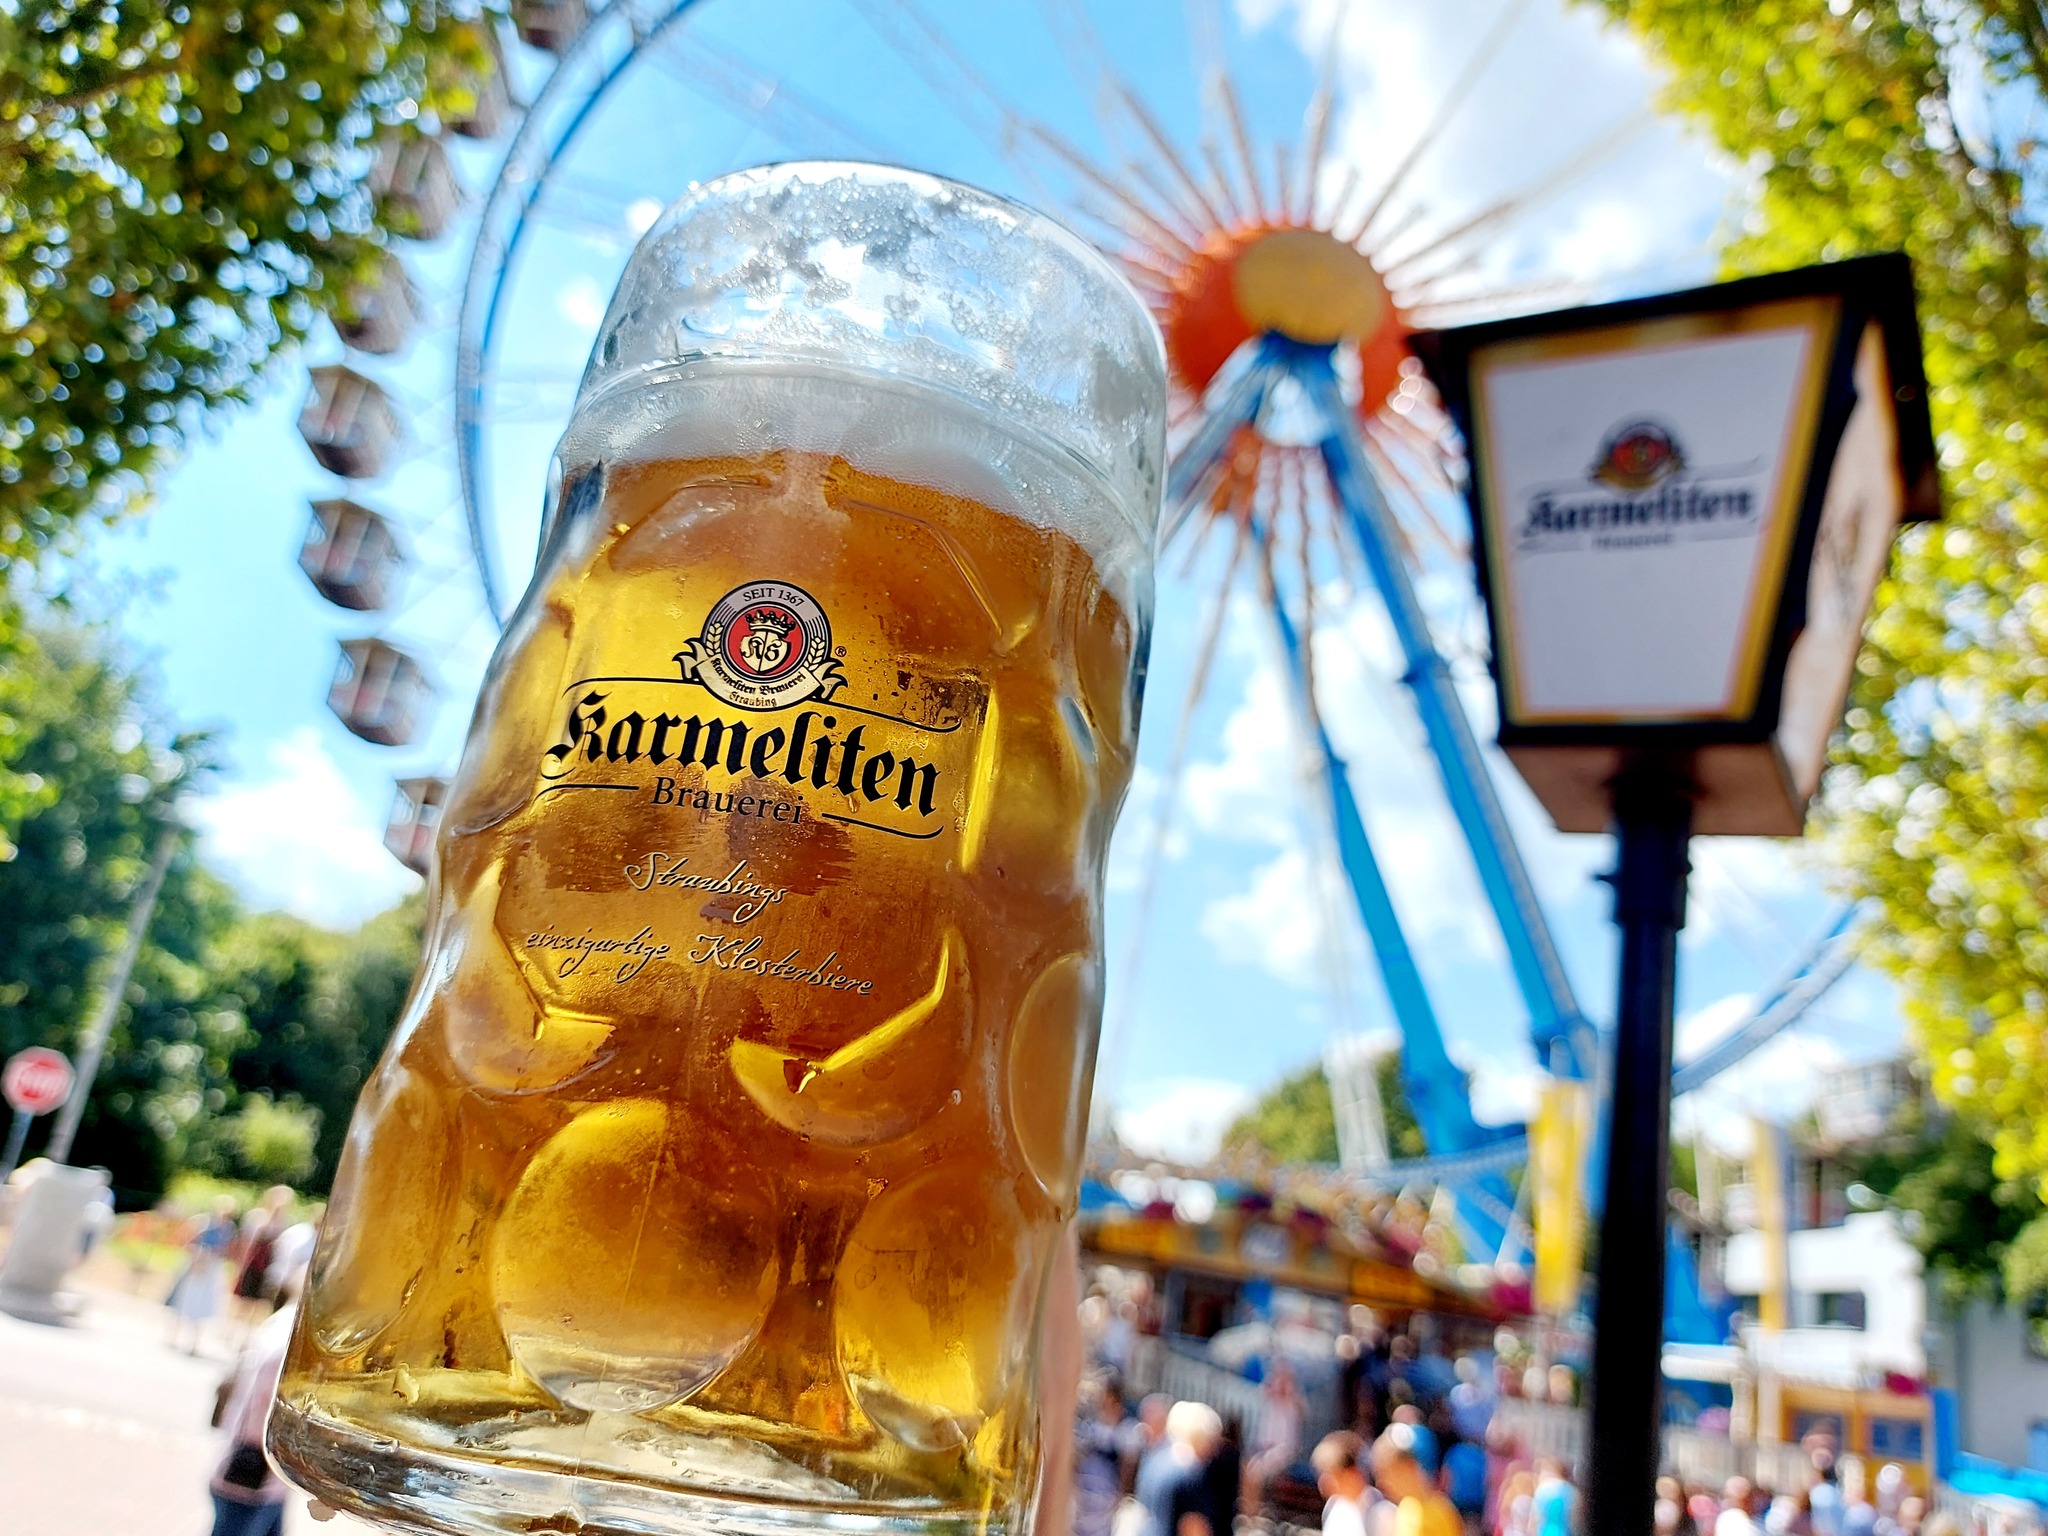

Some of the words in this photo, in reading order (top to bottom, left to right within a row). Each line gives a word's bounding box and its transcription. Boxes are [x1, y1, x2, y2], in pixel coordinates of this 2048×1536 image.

[742, 587, 775, 602] SEIT
[778, 589, 804, 607] 1367
[711, 657, 756, 695] Karmeliten
[759, 671, 807, 696] Brauerei
[729, 691, 778, 708] Straubing
[541, 688, 942, 818] Karmeliten
[650, 776, 804, 826] Brauerei
[625, 851, 788, 924] Straubings
[525, 924, 672, 985] einzigartige
[687, 933, 875, 996] Klosterbiere
